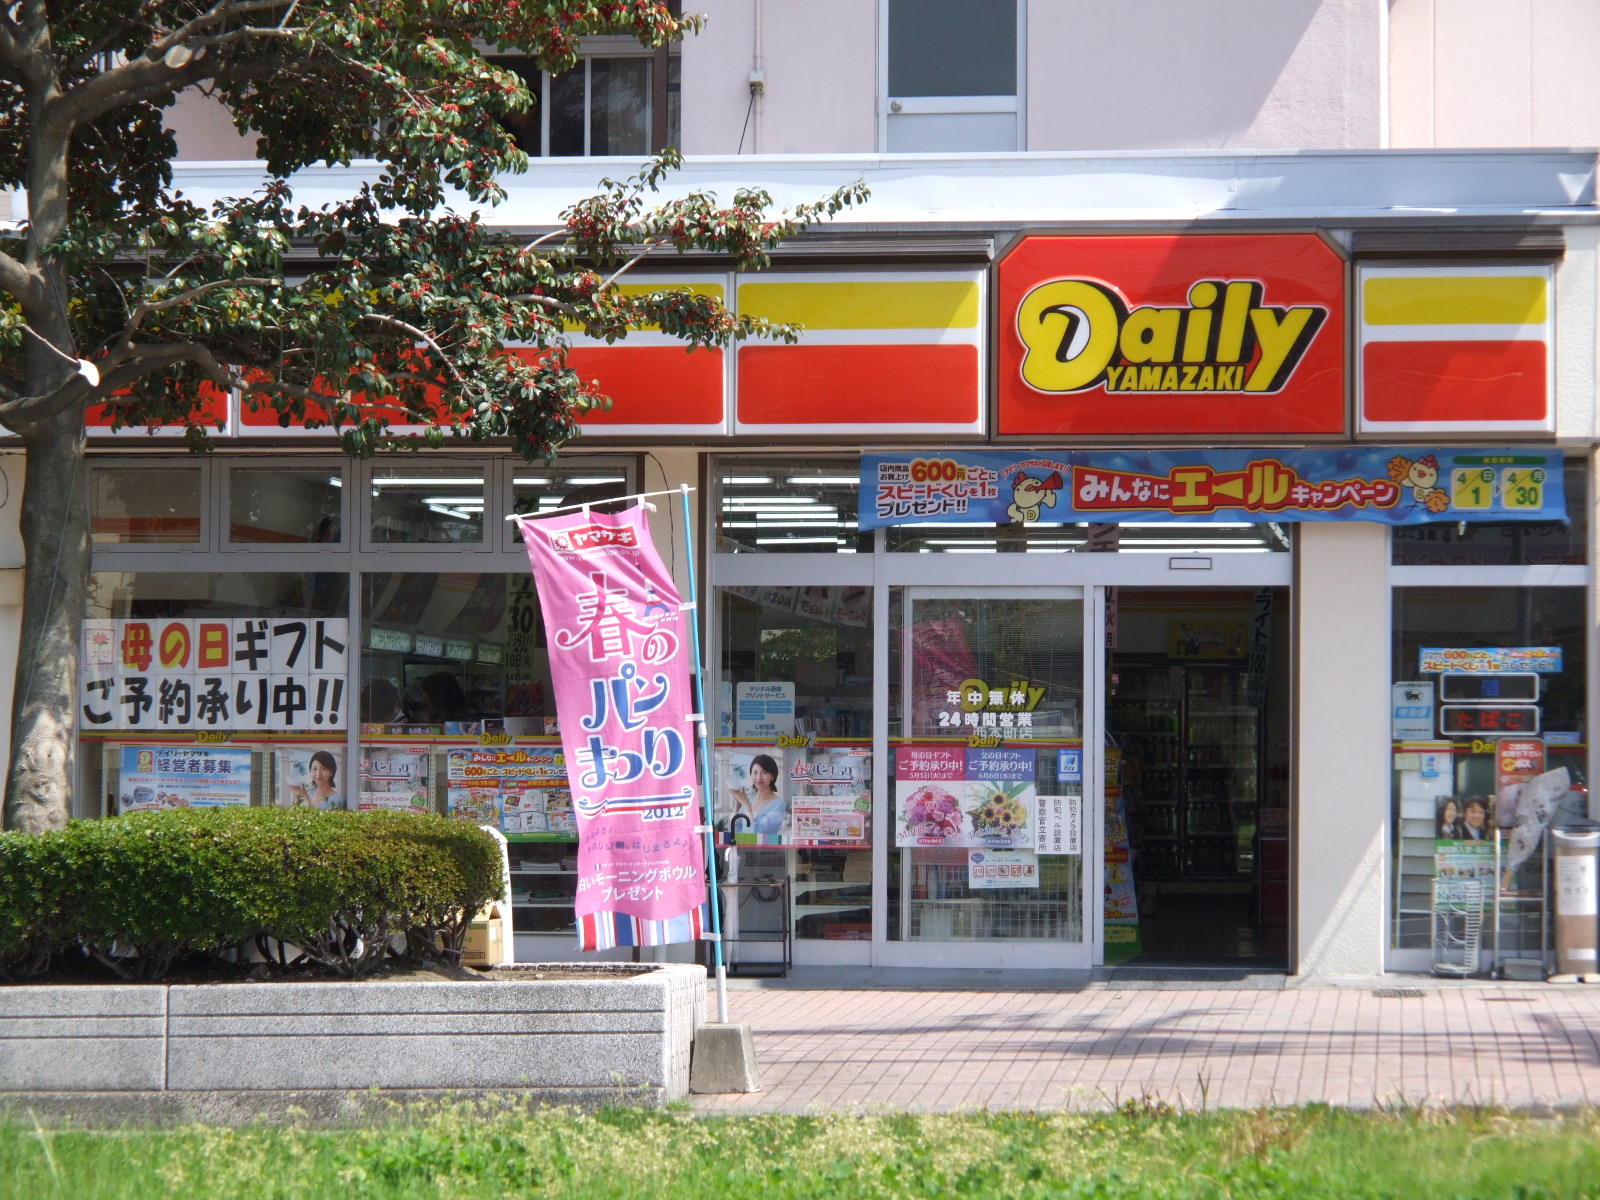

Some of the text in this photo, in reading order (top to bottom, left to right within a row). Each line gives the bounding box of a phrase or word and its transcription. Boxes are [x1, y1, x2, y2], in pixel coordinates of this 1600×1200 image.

[1017, 277, 1326, 393] Daily
[1107, 365, 1247, 392] YAMAZAKI
[1457, 473, 1466, 483] 4
[1508, 473, 1516, 483] 4
[878, 481, 997, 500] スピードくじを1枚
[1472, 487, 1480, 504] 1
[1516, 487, 1539, 505] 30
[878, 500, 967, 517] プレゼント!!
[507, 605, 535, 634] 30
[556, 571, 679, 664] 春の
[121, 619, 345, 672] 母の日ギフト
[83, 677, 344, 725] ご予約承り中!!
[581, 661, 670, 731] パン
[947, 690, 1025, 705] 年中無休
[939, 711, 1032, 727] 24時間営業
[1457, 711, 1523, 729] たばこ
[196, 731, 230, 743] Daily
[480, 732, 513, 745] Daily
[777, 735, 811, 748] Daily
[969, 735, 1001, 748] Daily
[157, 758, 232, 773] 経営者募集
[576, 728, 685, 790] まつり
[899, 760, 963, 772] ご予約承り中!
[969, 760, 1032, 772] ご予約承り中!
[643, 805, 685, 821] 2012
[579, 865, 698, 892] 白いモーニングボウル
[602, 885, 664, 903] プレゼント
